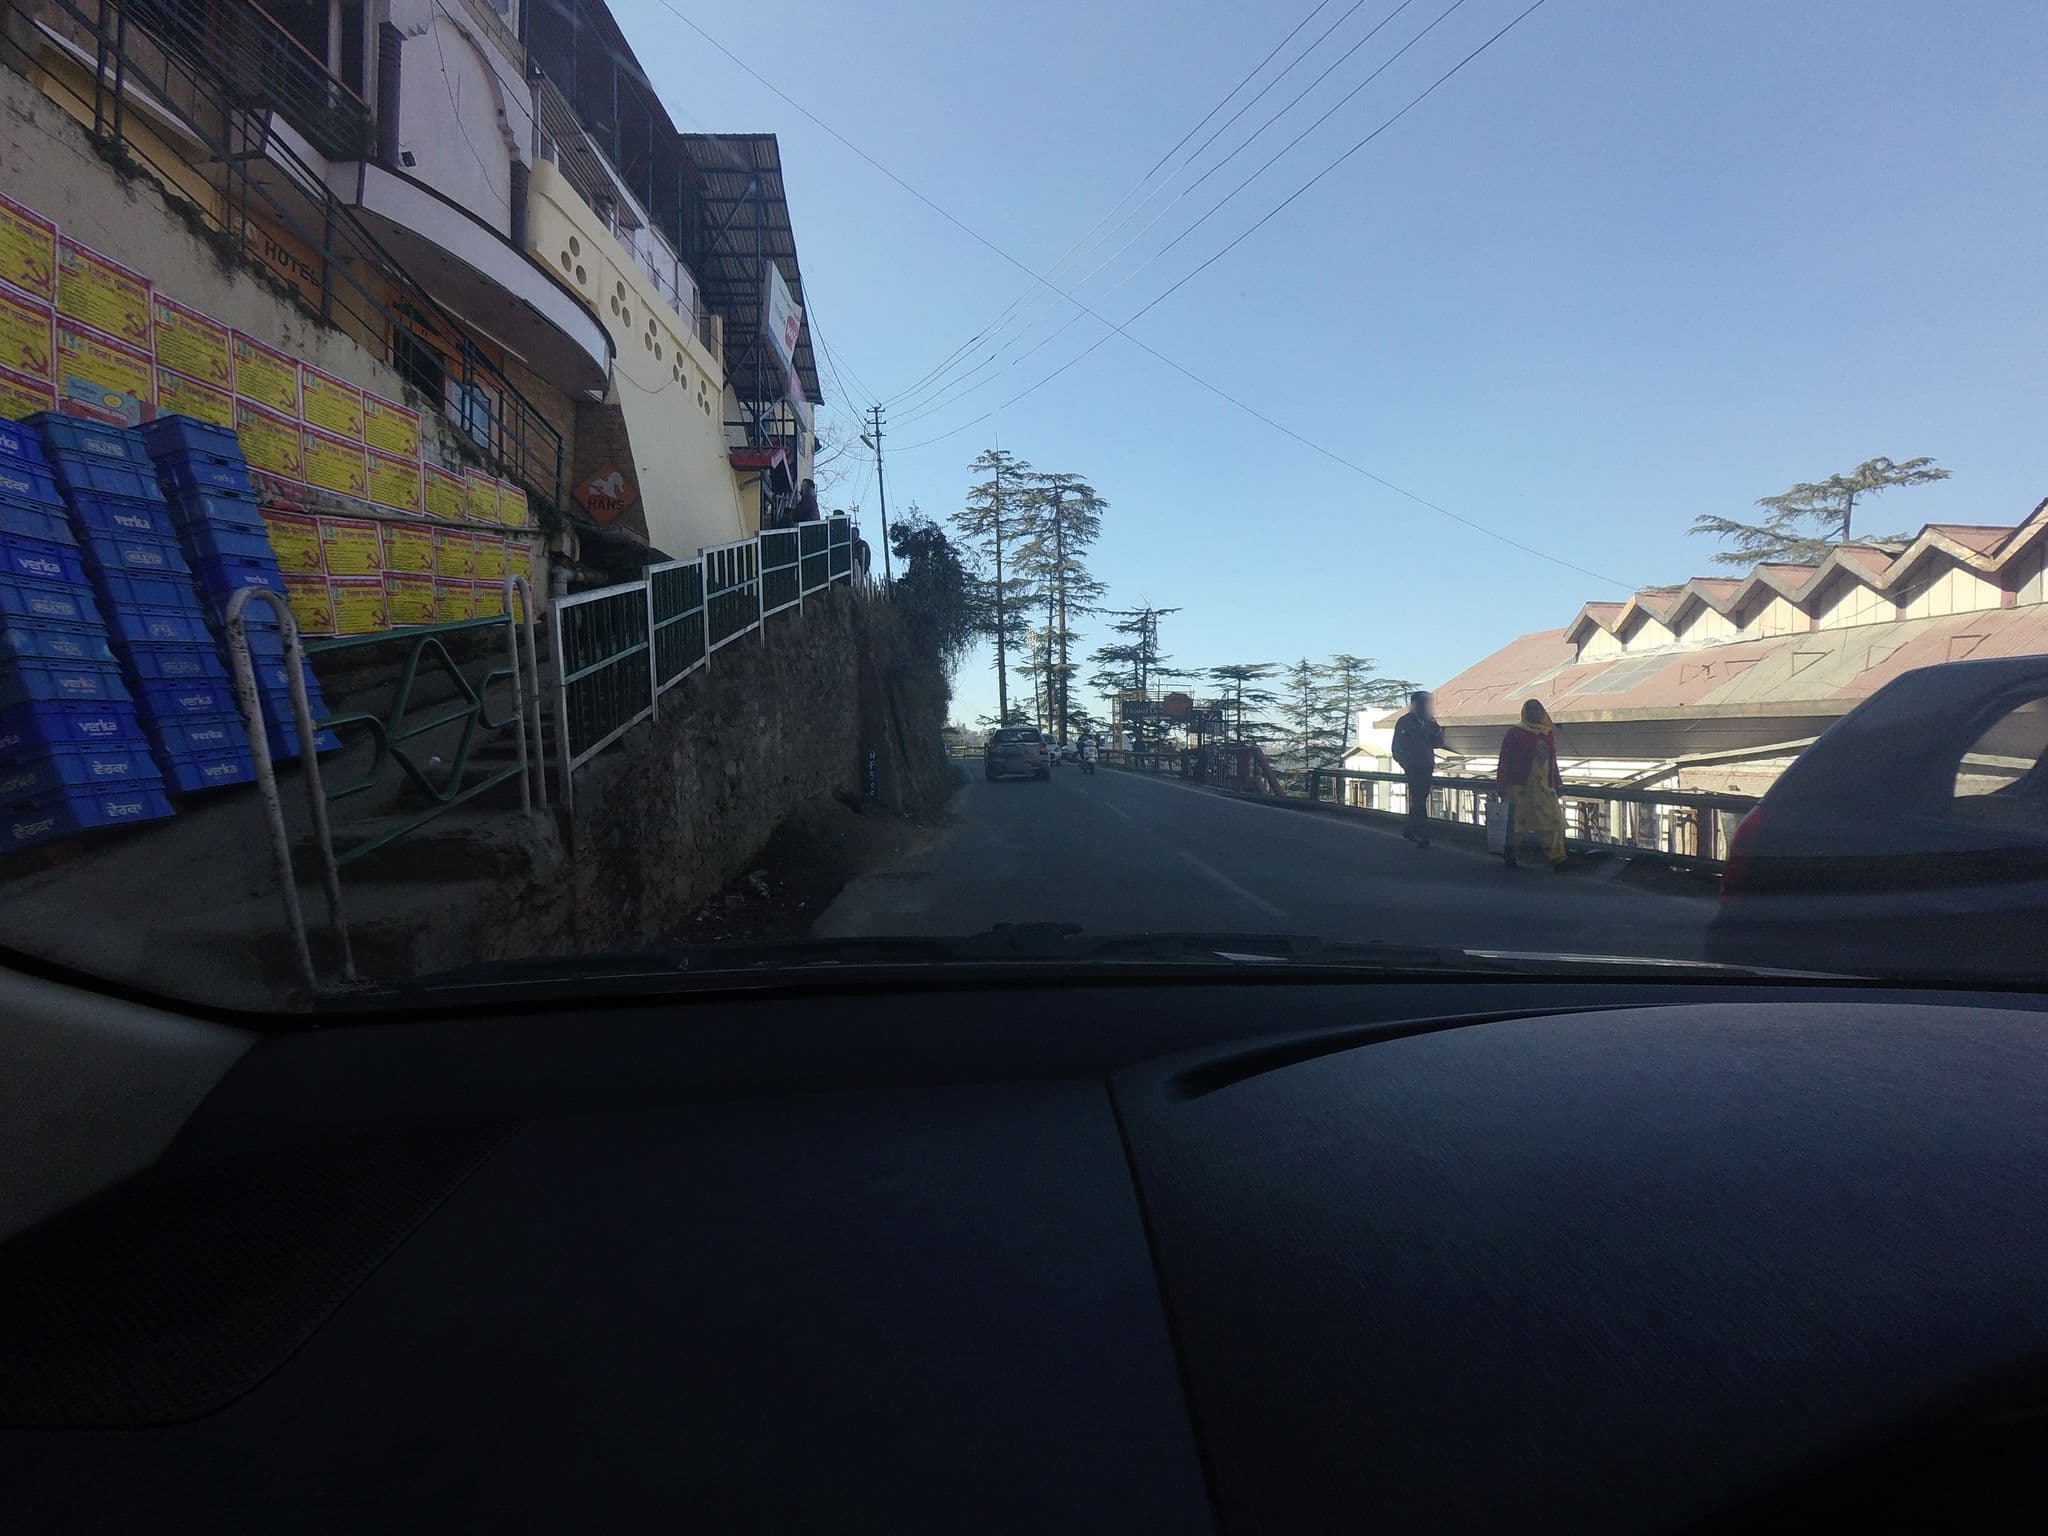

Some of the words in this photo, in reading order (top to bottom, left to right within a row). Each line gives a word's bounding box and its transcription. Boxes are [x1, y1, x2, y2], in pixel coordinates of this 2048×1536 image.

[264, 240, 319, 287] HOTEL
[588, 496, 625, 511] HANS
[18, 558, 61, 574] verka
[78, 718, 119, 733] verka
